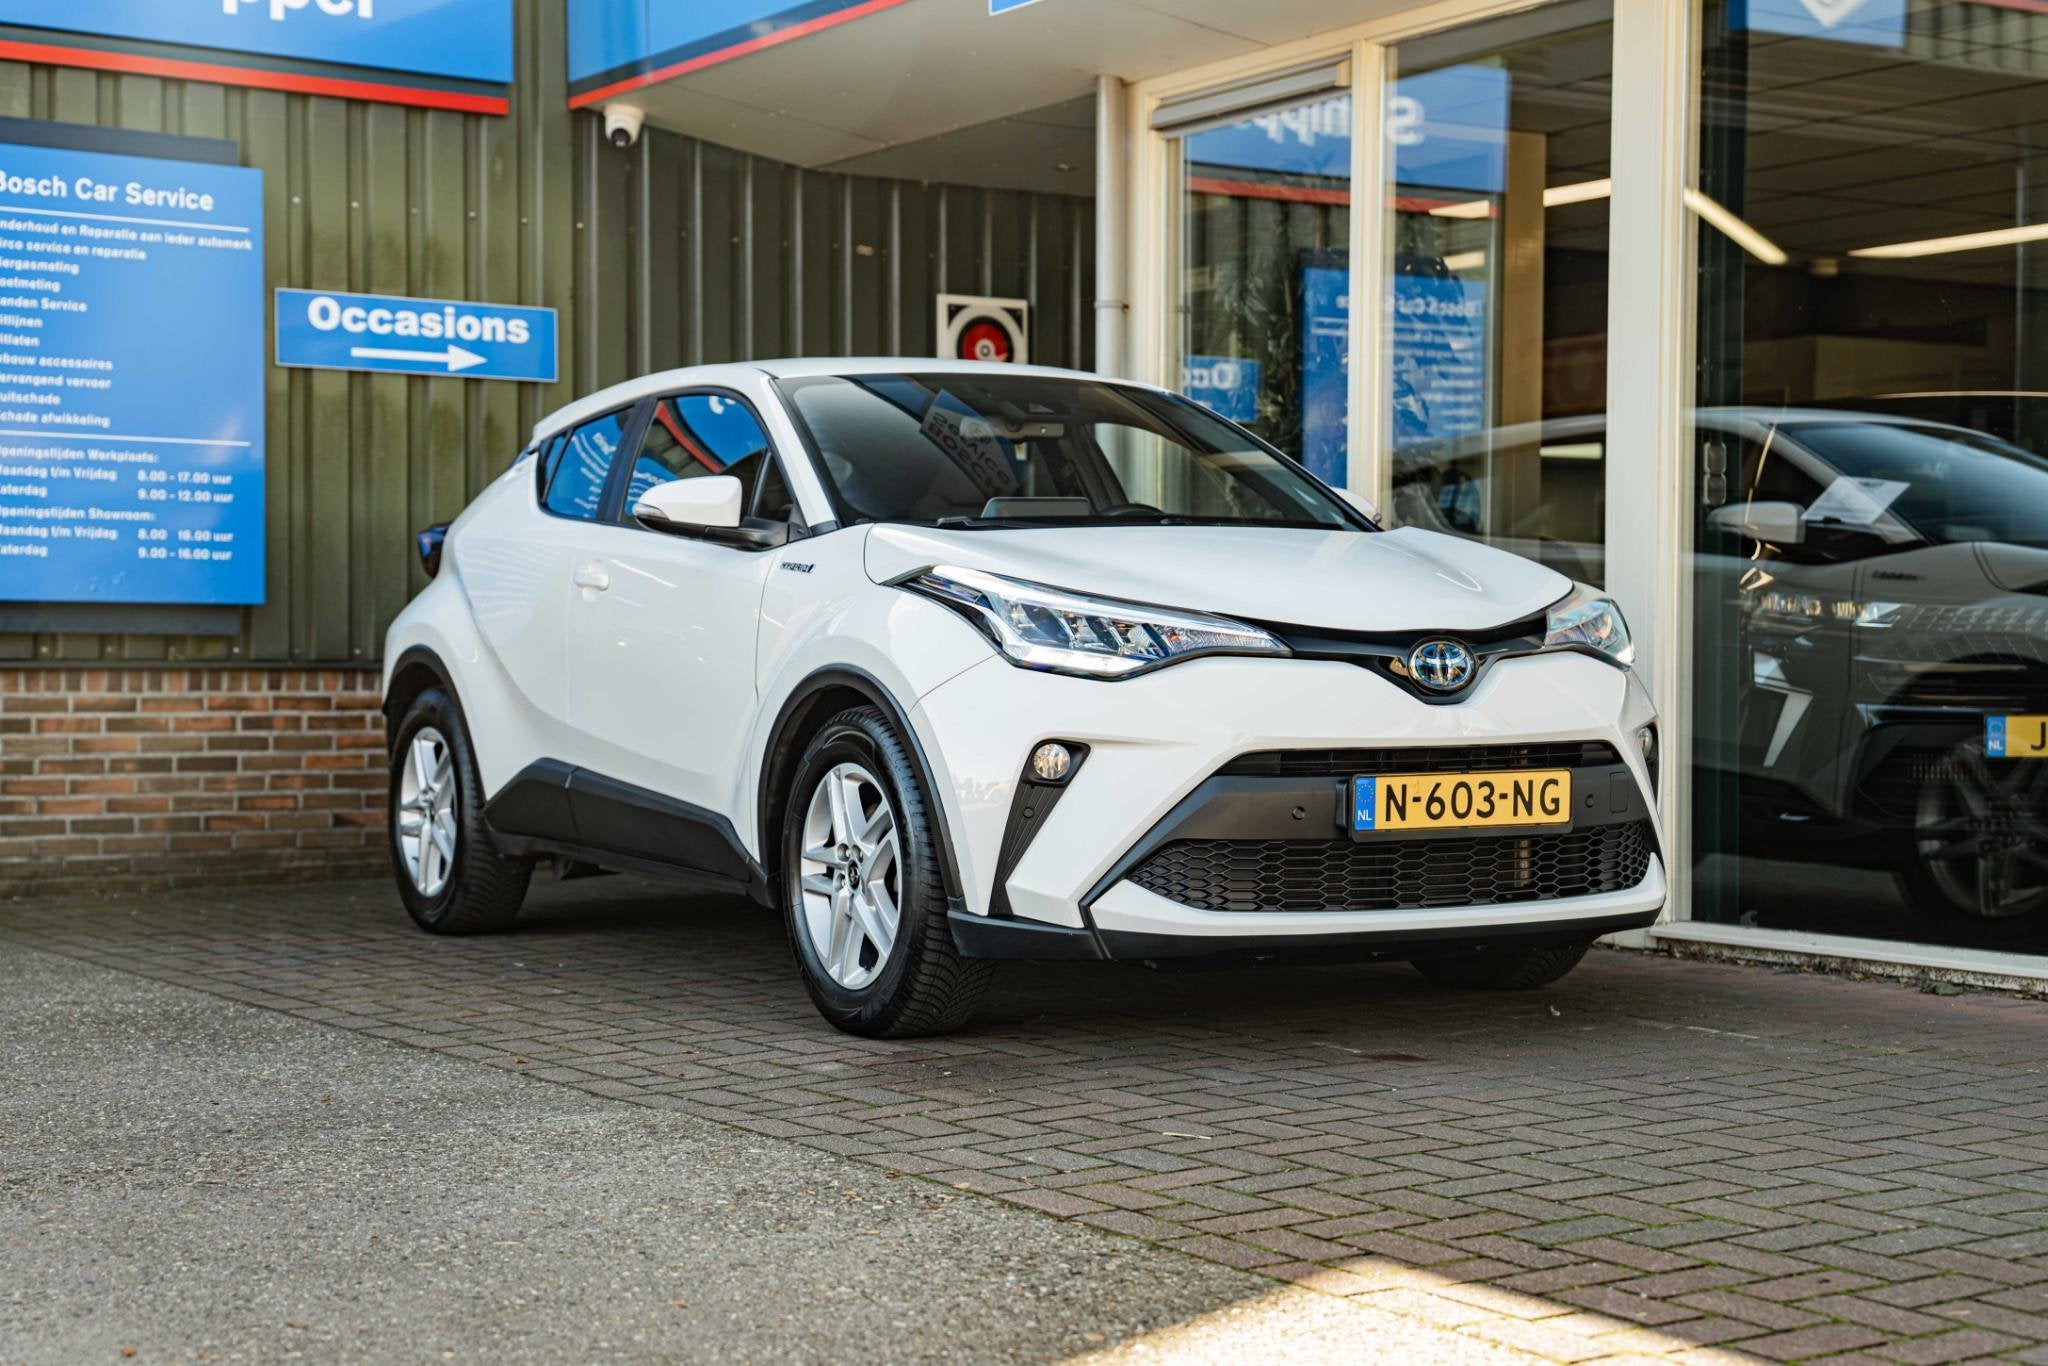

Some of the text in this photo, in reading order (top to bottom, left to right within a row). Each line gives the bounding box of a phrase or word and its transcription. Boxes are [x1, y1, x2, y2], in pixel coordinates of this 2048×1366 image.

[75, 177, 118, 202] Car
[125, 182, 215, 211] Service
[61, 225, 77, 236] en
[79, 224, 137, 241] Reparatie
[140, 231, 162, 243] aan
[164, 231, 195, 245] ieder
[198, 236, 253, 251] automerk
[26, 240, 71, 254] service
[74, 244, 89, 255] en
[92, 246, 147, 260] reparatie
[41, 297, 88, 312] Service
[307, 296, 530, 344] Occasions
[0, 353, 113, 371] bouw accessoires
[66, 377, 112, 389] vervoer
[0, 410, 111, 428] chade afwikkeling
[0, 446, 84, 462] peningstijden
[51, 466, 71, 478] t/m
[74, 467, 118, 482] Vrijdag
[177, 471, 210, 485] 17.00
[212, 474, 232, 485] uur
[0, 483, 48, 498] aterdag
[177, 489, 212, 503] 12.00
[213, 492, 234, 503] uur
[0, 504, 84, 521] peningstijden
[51, 524, 71, 538] t/m
[74, 526, 118, 541] Vrijdag
[213, 532, 234, 543] uur
[0, 543, 48, 558] aterdag
[212, 550, 232, 561] uur
[1988, 740, 2003, 751] NL
[1385, 778, 1560, 822] N-603-NG
[1358, 809, 1373, 821] NL
